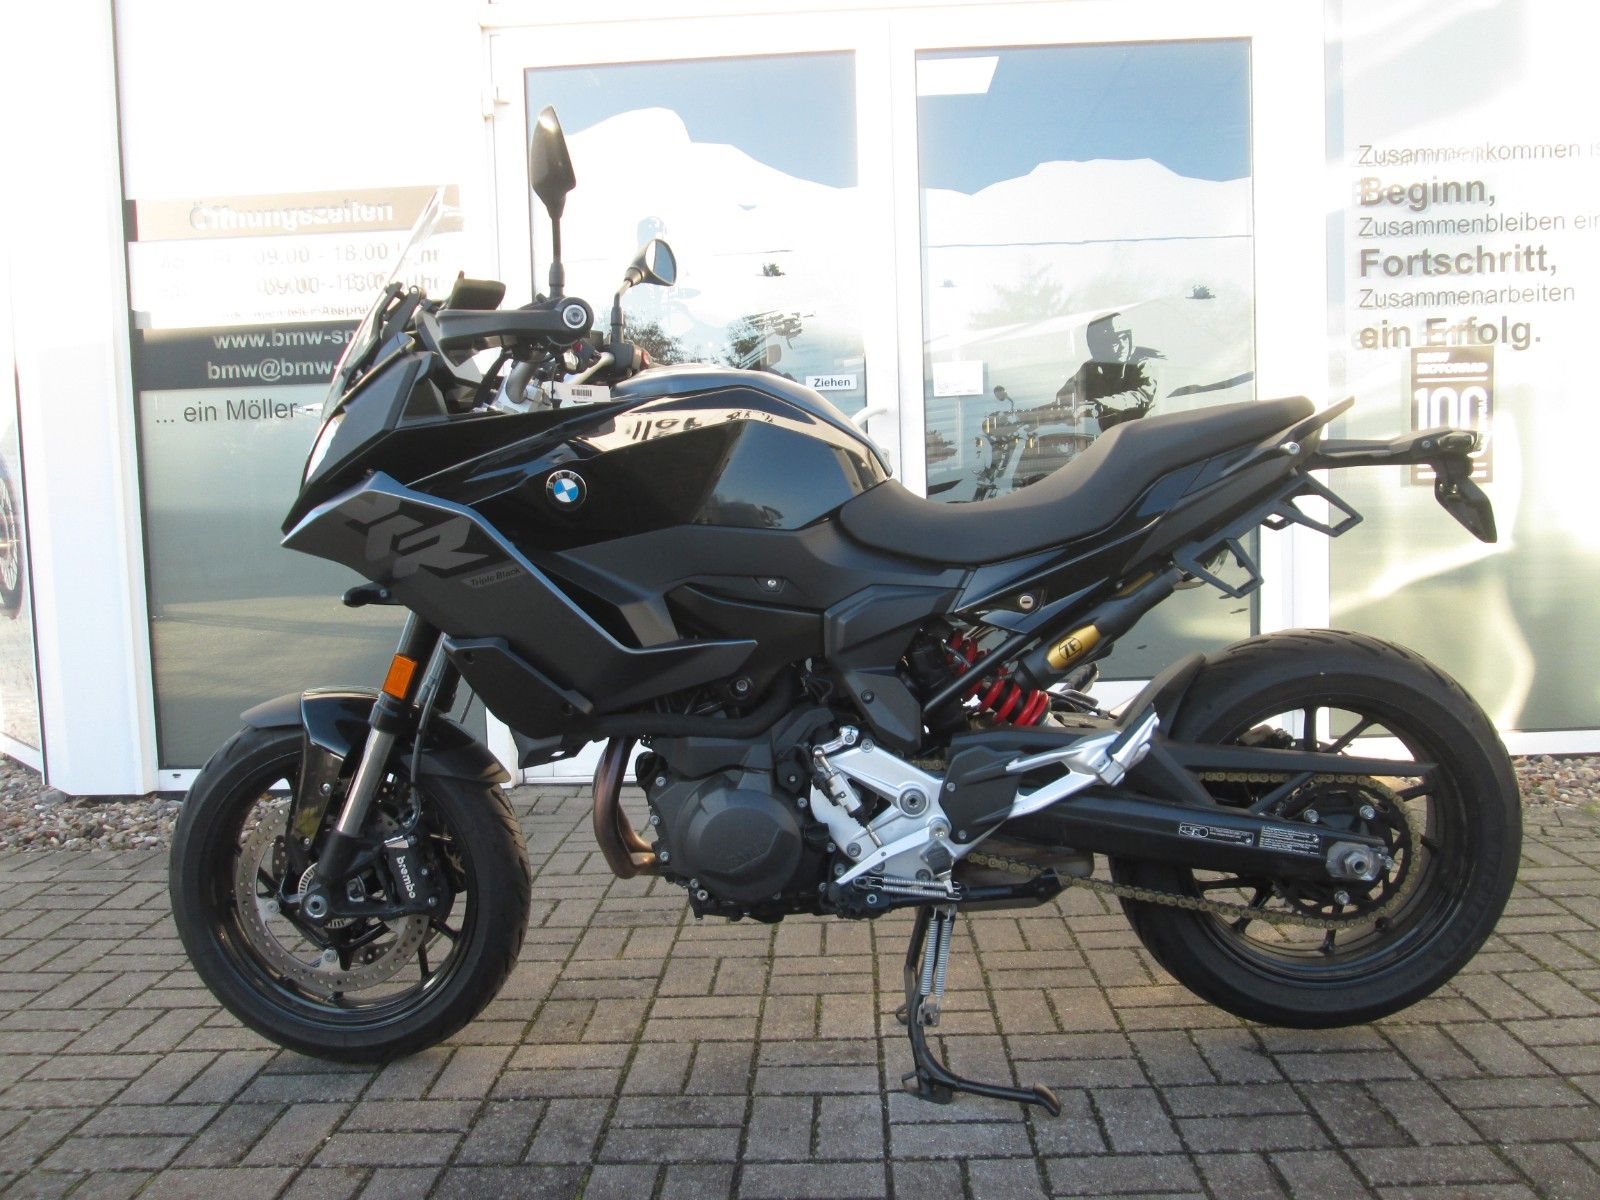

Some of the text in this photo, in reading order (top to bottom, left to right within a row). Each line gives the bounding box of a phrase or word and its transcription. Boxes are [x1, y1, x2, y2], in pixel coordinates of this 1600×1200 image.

[1359, 175, 1496, 212] Beginn,
[1358, 212, 1565, 237] Zusammenbleiben
[1359, 243, 1557, 278] Fortschritt,
[1358, 282, 1576, 309] Zusammenarbeiten
[1359, 315, 1541, 351] ein Erfolg.
[813, 377, 851, 388] Ziehen
[183, 402, 218, 423] ein
[226, 397, 298, 422] Möller
[496, 566, 521, 581] Black
[396, 855, 416, 899] brembo
